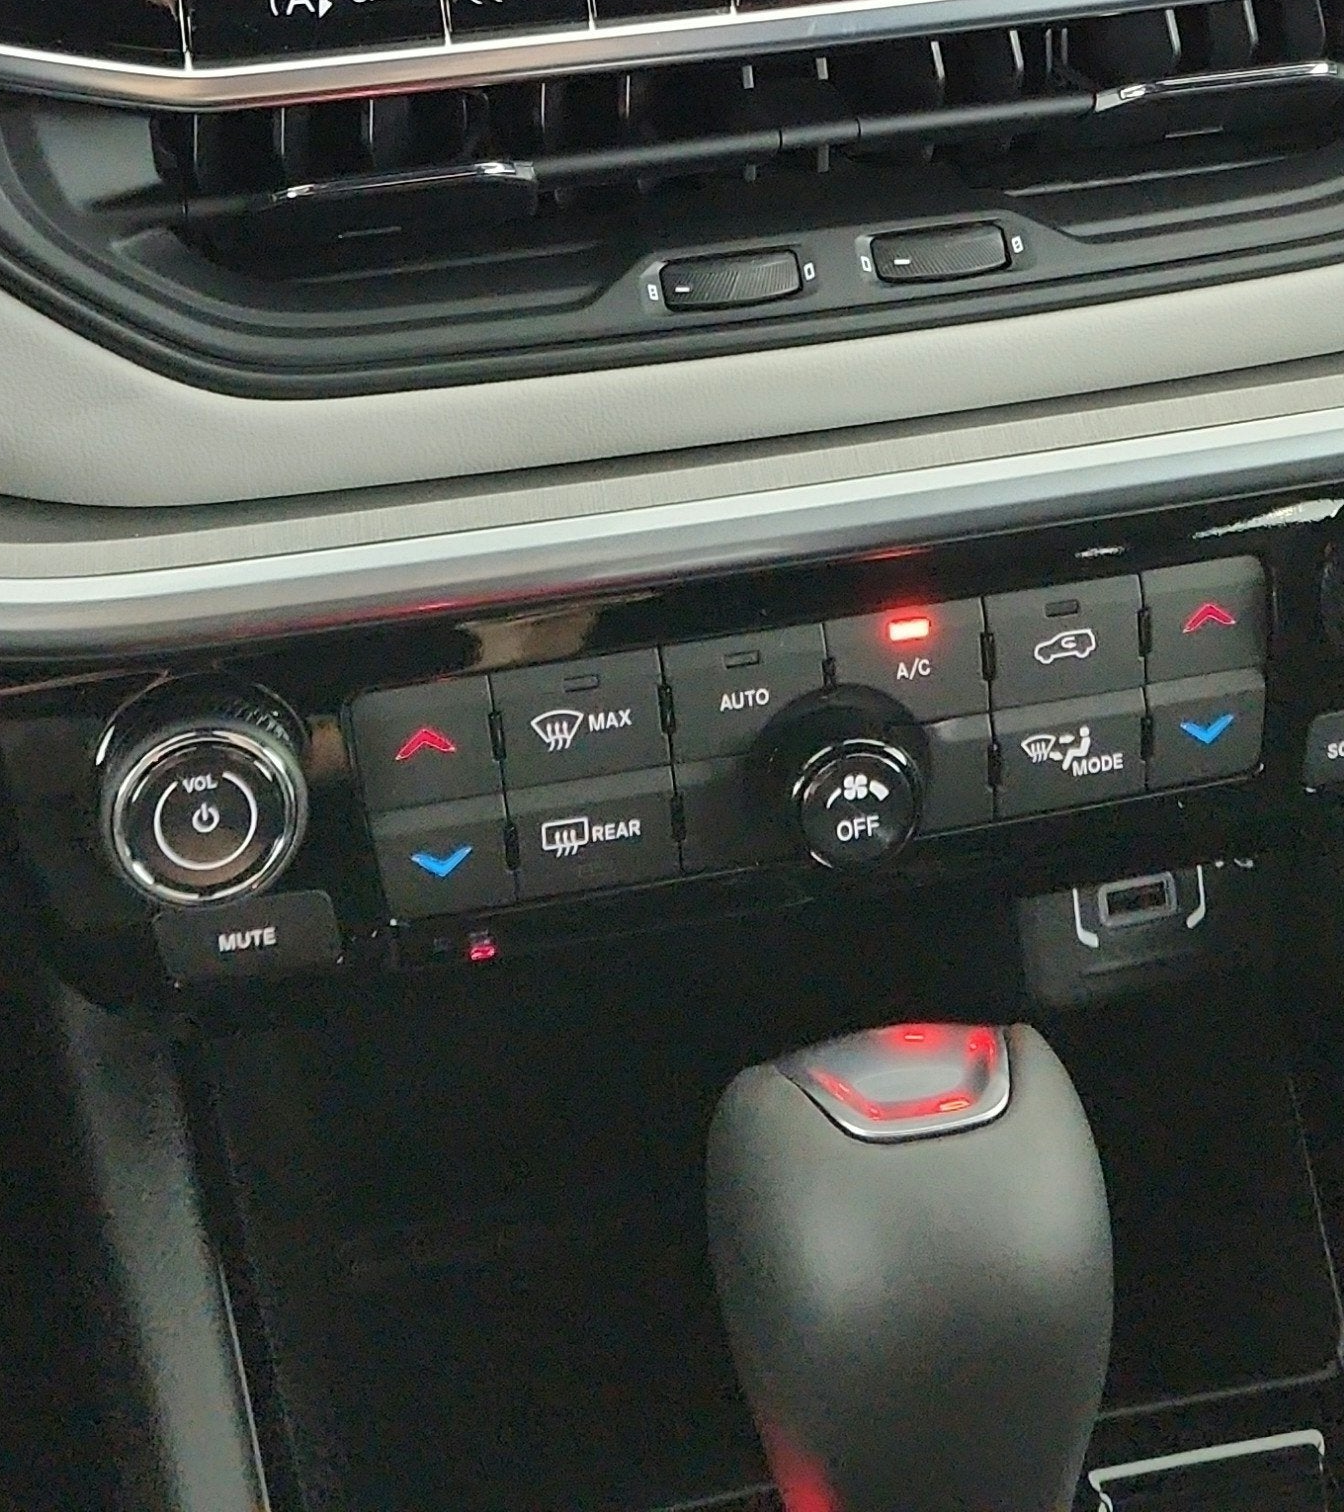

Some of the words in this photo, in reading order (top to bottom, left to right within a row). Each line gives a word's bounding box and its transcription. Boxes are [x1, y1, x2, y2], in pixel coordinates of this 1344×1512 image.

[896, 657, 931, 680] A/C
[720, 688, 770, 712] AUTO
[588, 708, 633, 732] MAX
[1071, 753, 1124, 778] MODE
[182, 774, 218, 794] VOL
[592, 818, 642, 843] REAR
[836, 817, 880, 843] OFF
[218, 927, 277, 952] MUTE
